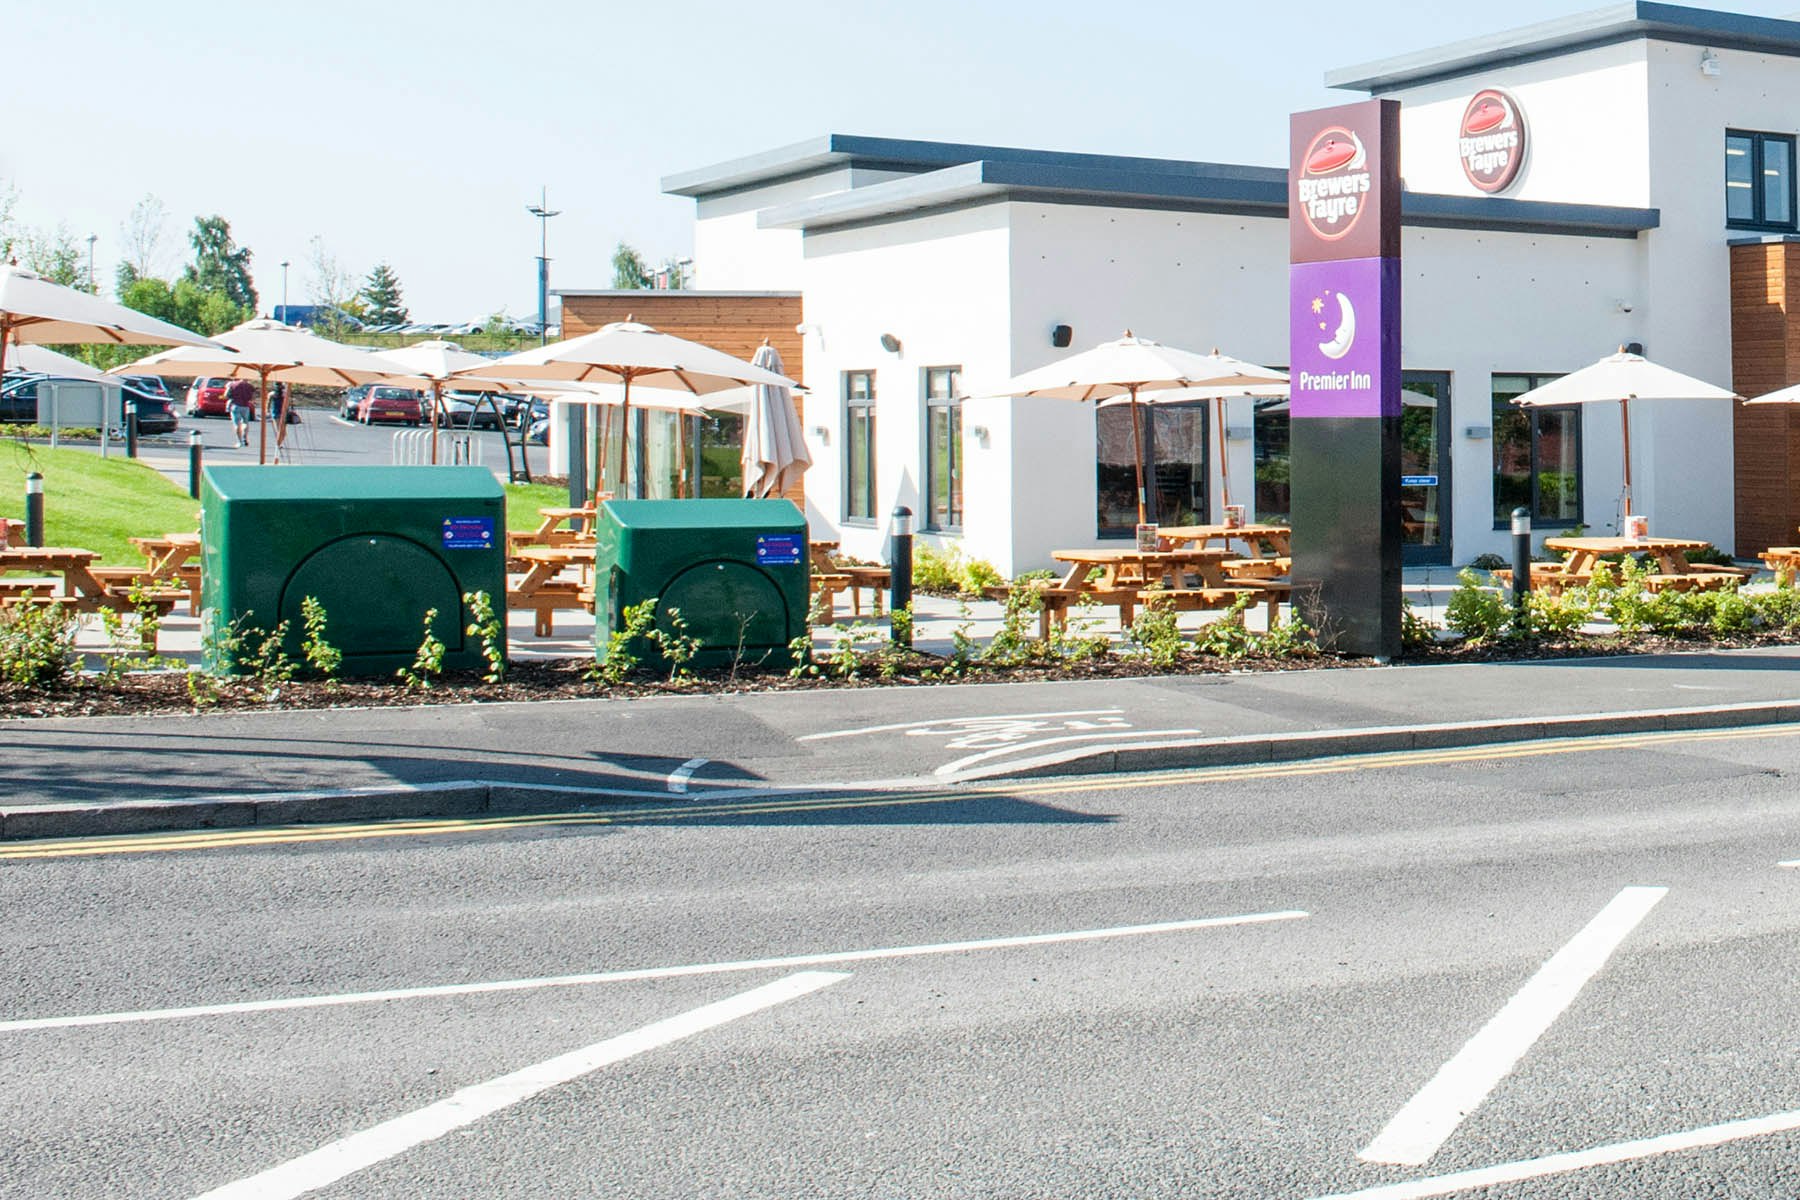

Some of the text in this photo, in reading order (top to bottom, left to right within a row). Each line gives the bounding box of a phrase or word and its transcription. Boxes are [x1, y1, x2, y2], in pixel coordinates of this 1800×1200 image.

[1459, 130, 1518, 157] Brewers
[1298, 173, 1370, 202] Brewers
[1300, 370, 1371, 391] Premier Inn
